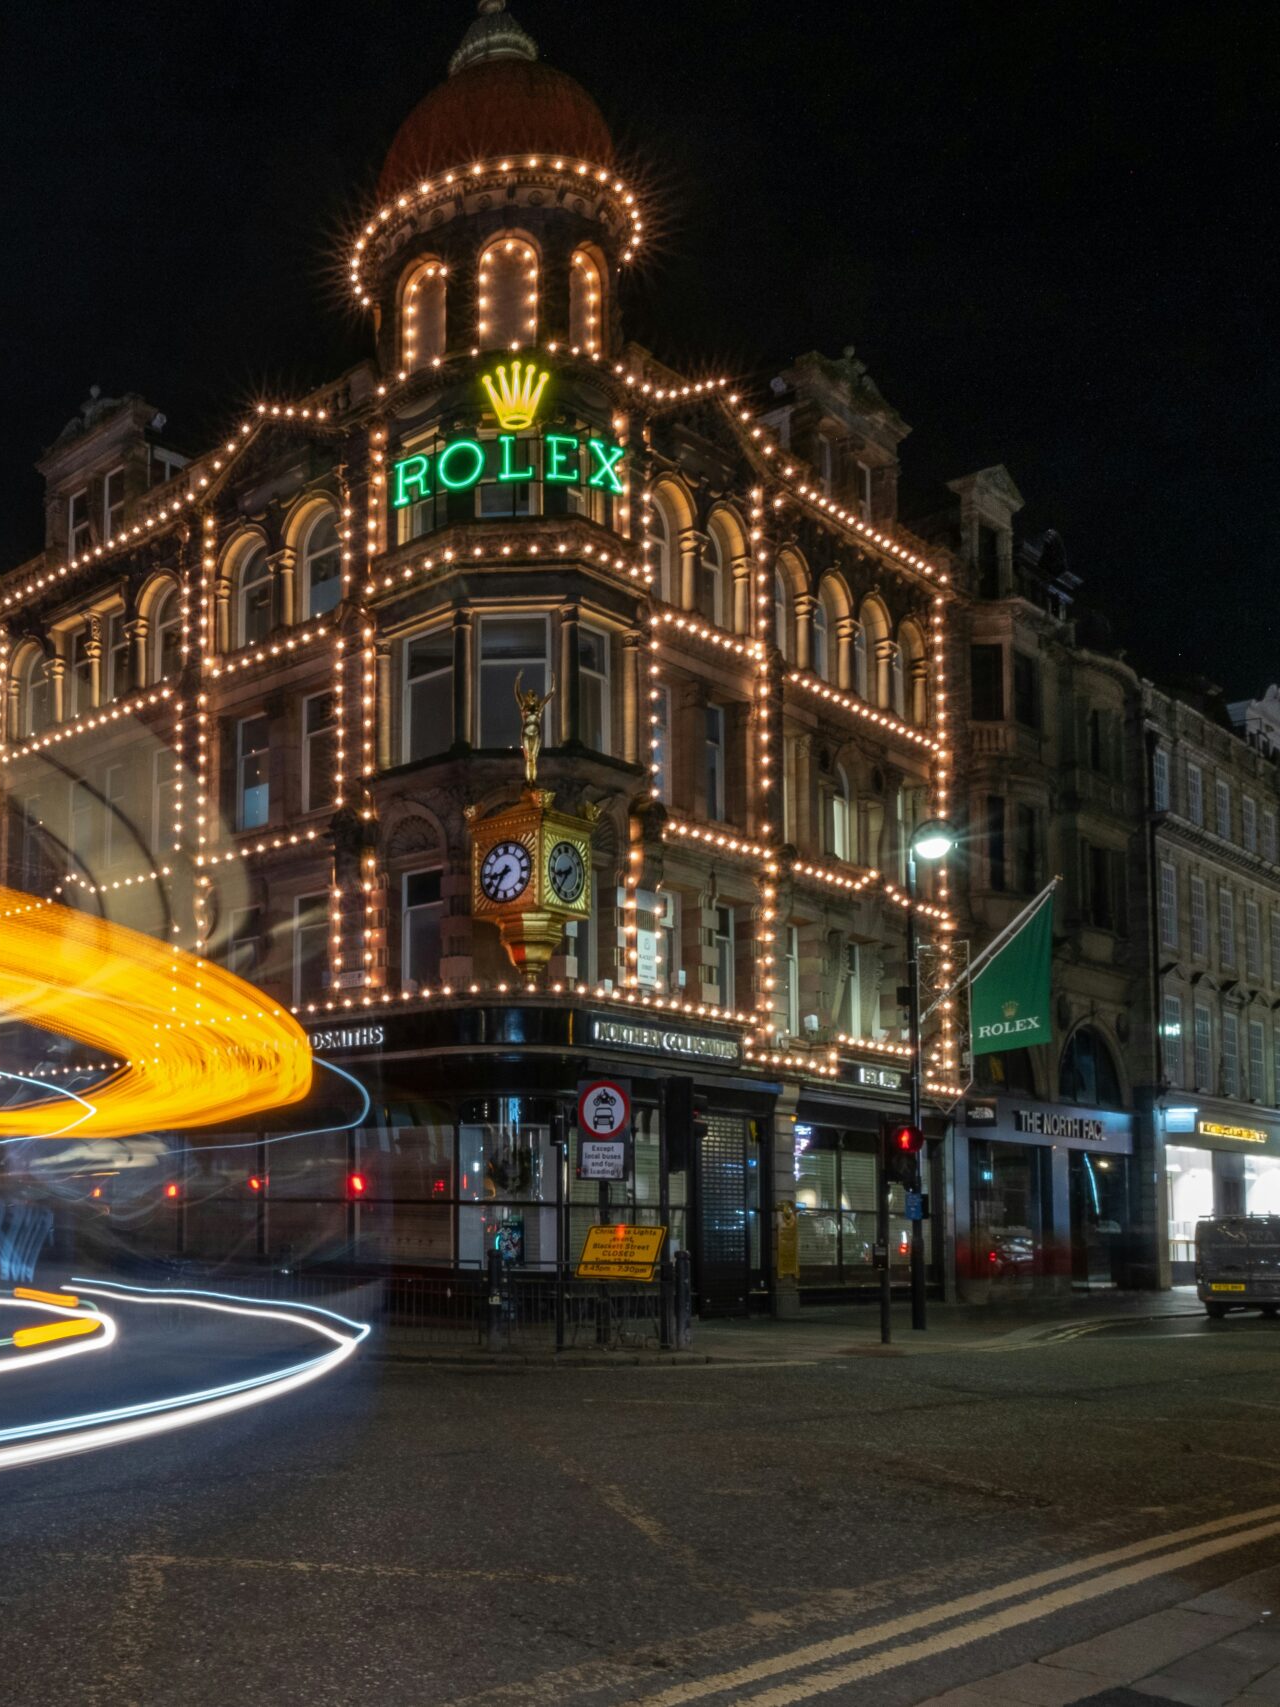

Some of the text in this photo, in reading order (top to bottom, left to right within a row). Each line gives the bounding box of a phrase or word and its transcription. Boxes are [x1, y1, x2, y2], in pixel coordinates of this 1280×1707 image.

[393, 434, 626, 508] ROLEX
[978, 1015, 1041, 1039] ROLEX
[594, 1021, 738, 1059] NORTHERN GOLDSMITHS
[1020, 1110, 1108, 1142] THE NORTH FACE
[584, 1152, 622, 1160] local buses
[591, 1144, 615, 1152] Except
[633, 1228, 656, 1236] Lights
[625, 1243, 650, 1251] Street
